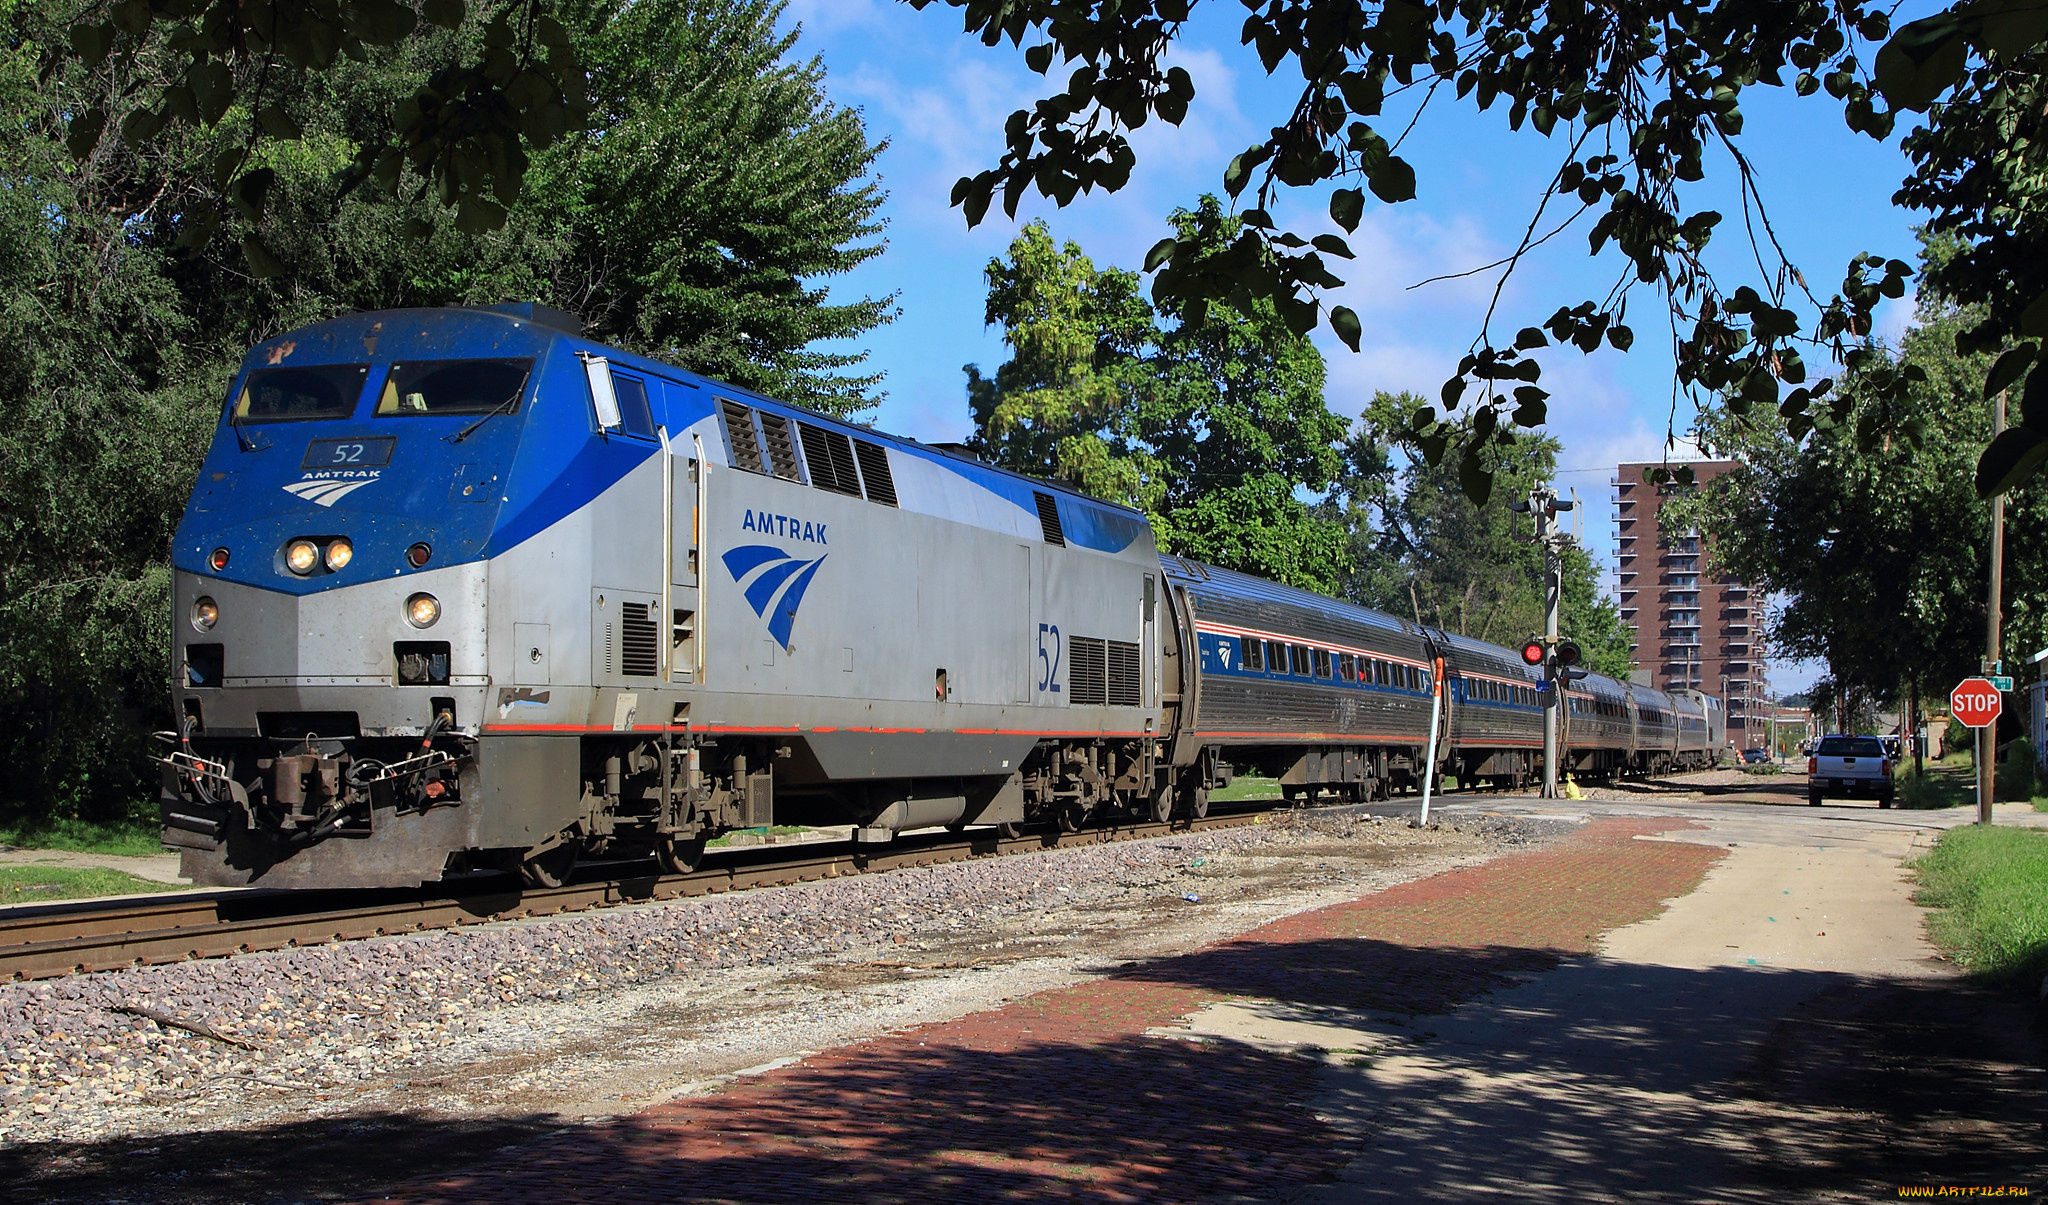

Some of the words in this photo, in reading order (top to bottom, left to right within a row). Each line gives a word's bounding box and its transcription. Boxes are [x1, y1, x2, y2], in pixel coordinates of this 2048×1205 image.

[332, 444, 364, 463] 52
[301, 470, 381, 480] AMTRAK
[742, 508, 827, 545] AMTRAK
[1038, 623, 1061, 693] 52
[1954, 694, 1998, 712] STOP
